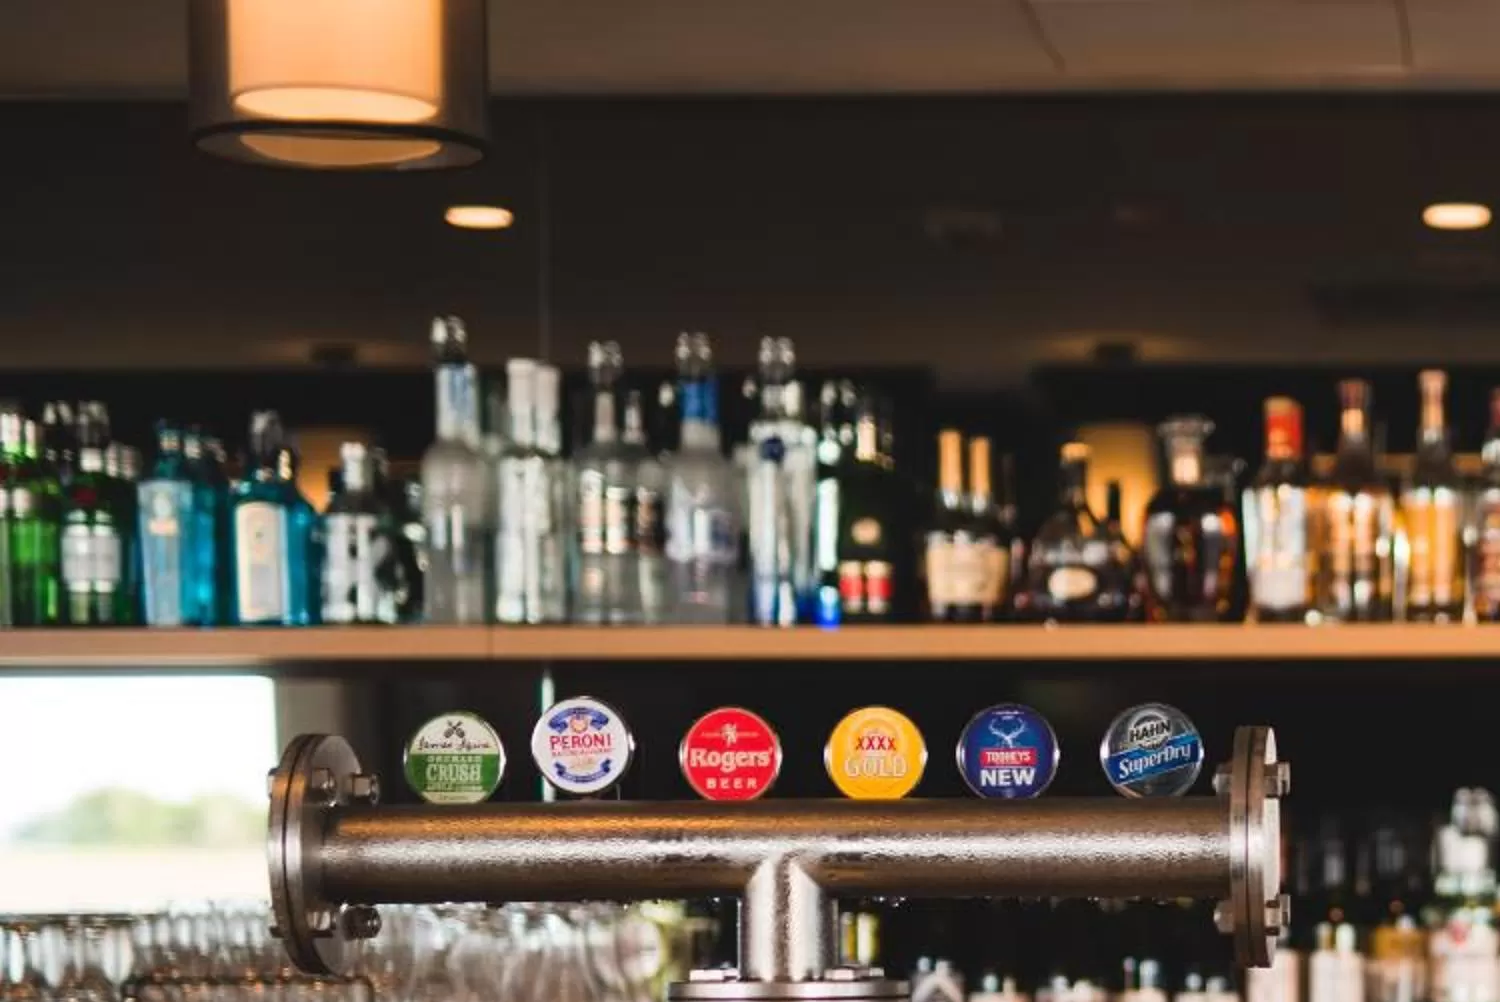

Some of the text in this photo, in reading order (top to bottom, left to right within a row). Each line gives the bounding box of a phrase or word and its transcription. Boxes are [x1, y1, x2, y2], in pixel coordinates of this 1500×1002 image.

[1128, 719, 1171, 742] HAHN
[549, 733, 612, 751] PERONI
[855, 735, 897, 751] XXXX
[844, 755, 907, 778] GOLD
[1119, 743, 1192, 779] SuperDry
[426, 763, 481, 781] CRUSH
[980, 767, 1037, 787] NEW
[706, 777, 757, 790] BEER
